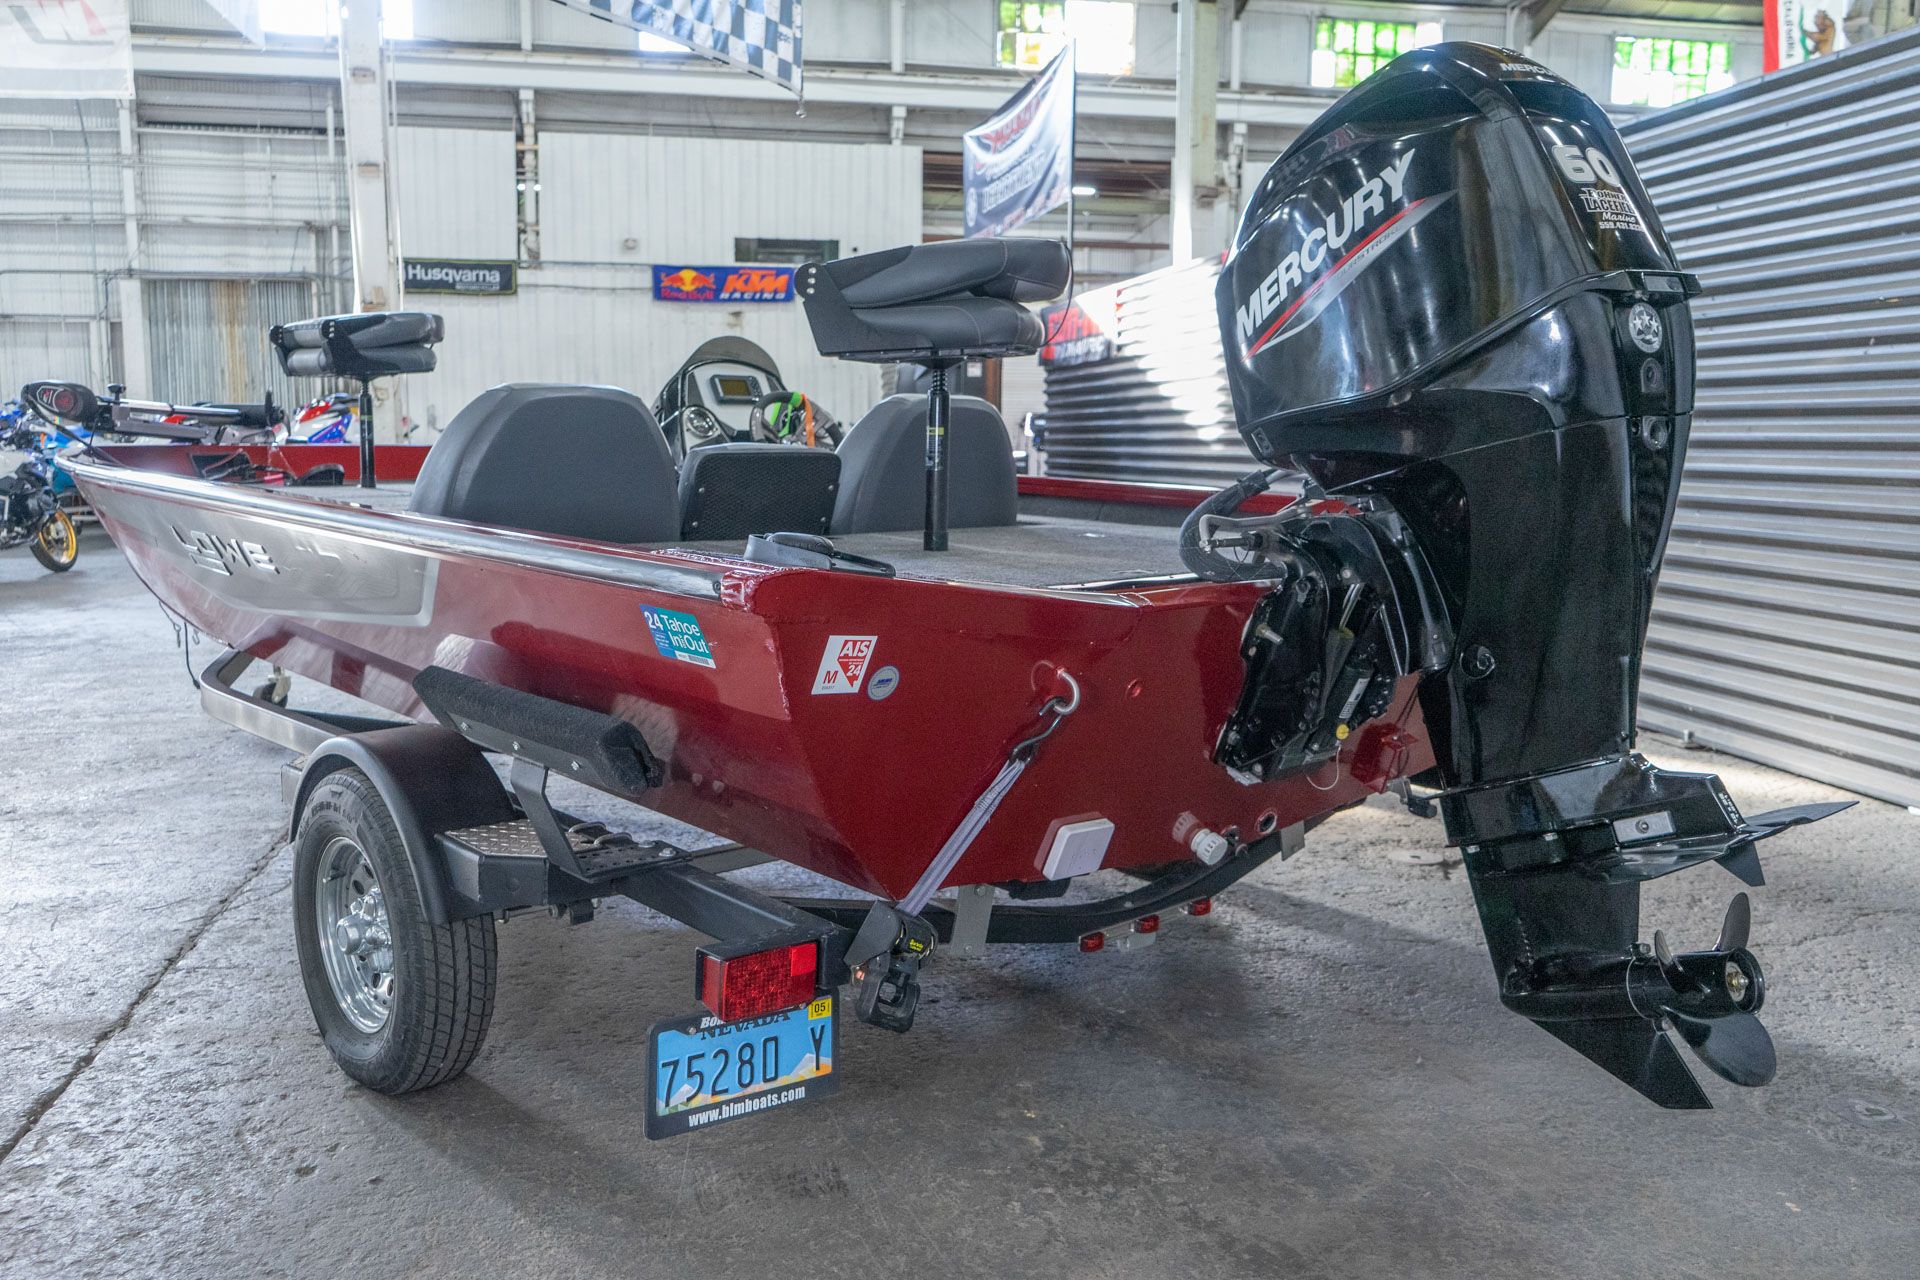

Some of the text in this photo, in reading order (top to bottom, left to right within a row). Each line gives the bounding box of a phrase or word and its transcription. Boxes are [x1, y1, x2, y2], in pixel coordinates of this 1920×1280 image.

[1551, 145, 1620, 187] 60
[1585, 197, 1635, 213] LACEFIEL
[1236, 148, 1415, 343] MERCURY
[407, 264, 500, 283] Husqvarna
[723, 269, 789, 293] KTM
[720, 292, 786, 300] RACING
[171, 525, 280, 576] LOWE
[644, 611, 664, 631] 24
[660, 614, 701, 637] Tahoe
[683, 634, 709, 654] Out
[840, 641, 870, 657] AIS
[823, 670, 838, 684] M
[846, 664, 862, 676] 24
[814, 1001, 826, 1014] 05
[661, 1024, 825, 1108] 75280 Y
[688, 1085, 806, 1127] www.blmboats.com
